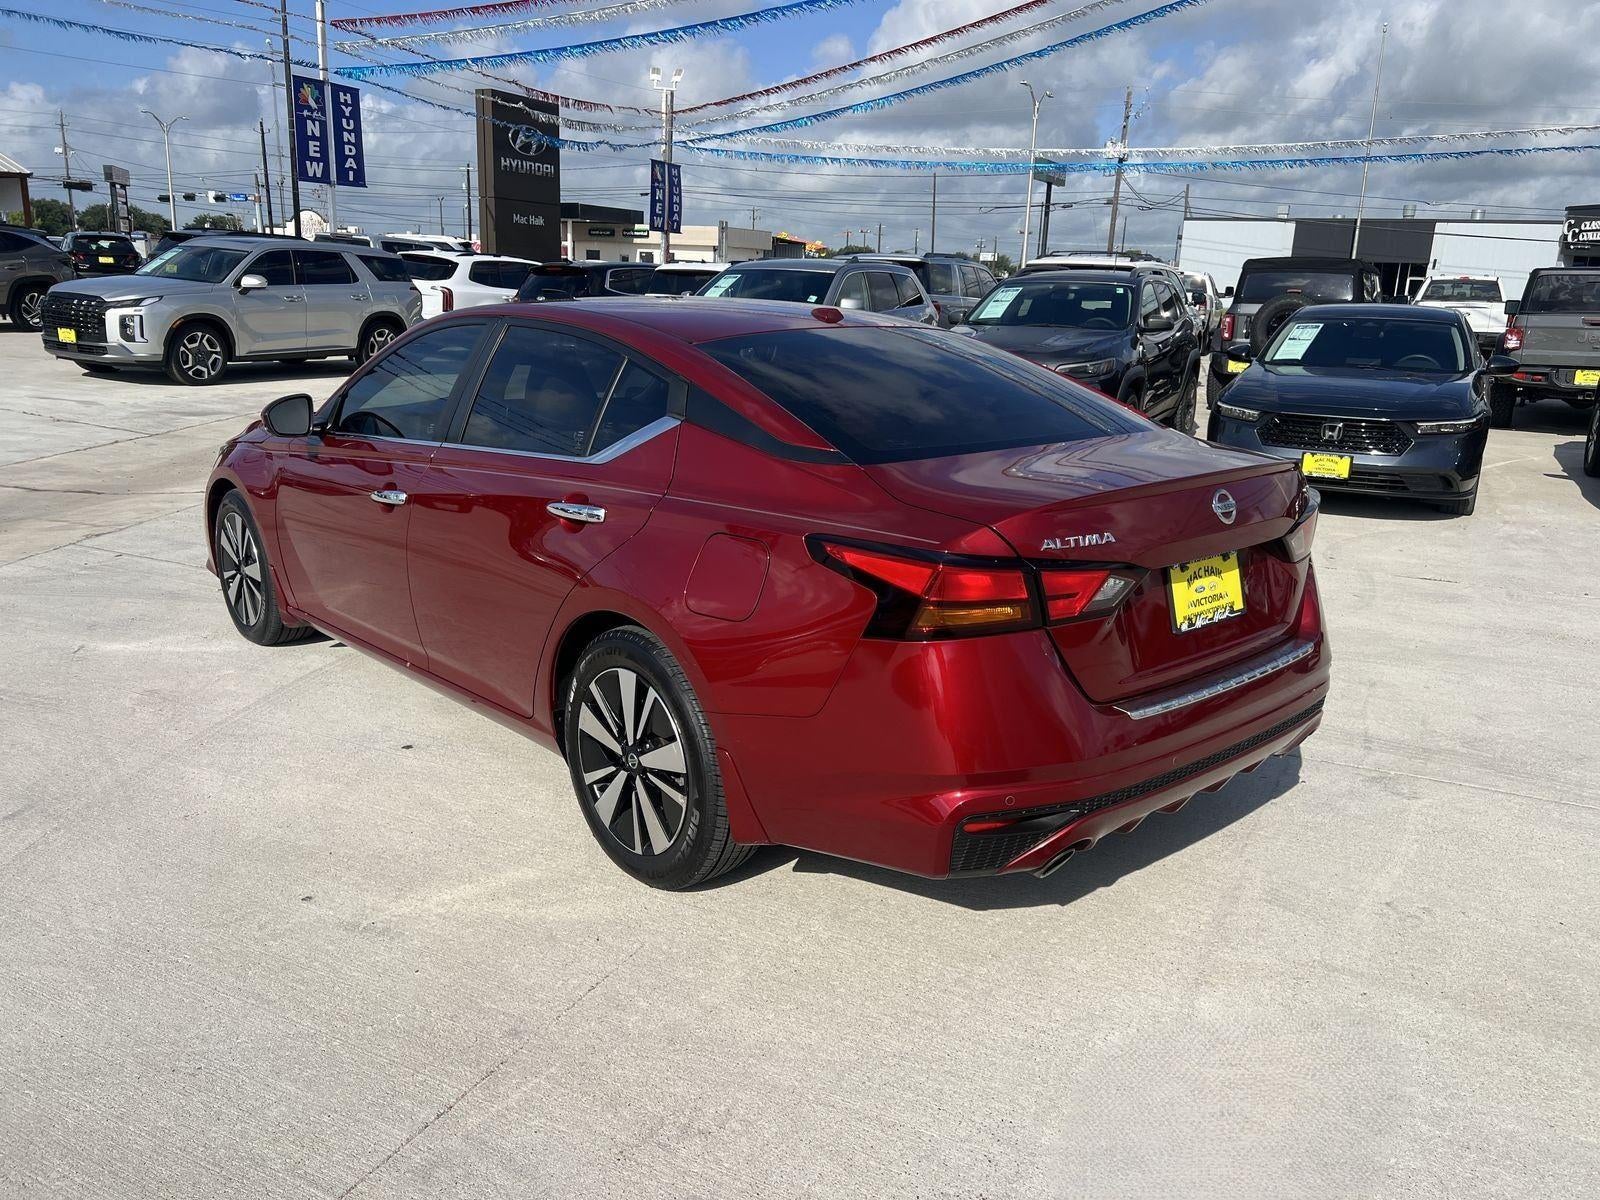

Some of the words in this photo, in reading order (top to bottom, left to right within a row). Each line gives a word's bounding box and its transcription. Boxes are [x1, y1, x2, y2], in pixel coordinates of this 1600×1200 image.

[305, 119, 324, 178] NEW
[339, 91, 358, 182] HYUNDAI
[501, 156, 555, 177] HYUNDAI
[653, 188, 663, 228] NEW
[671, 168, 680, 230] HYUNDAI
[513, 213, 528, 225] Mac
[529, 214, 545, 226] Haik
[1040, 532, 1116, 551] ALTIMA
[1186, 567, 1203, 590] MAC
[1203, 565, 1224, 581] HAIK
